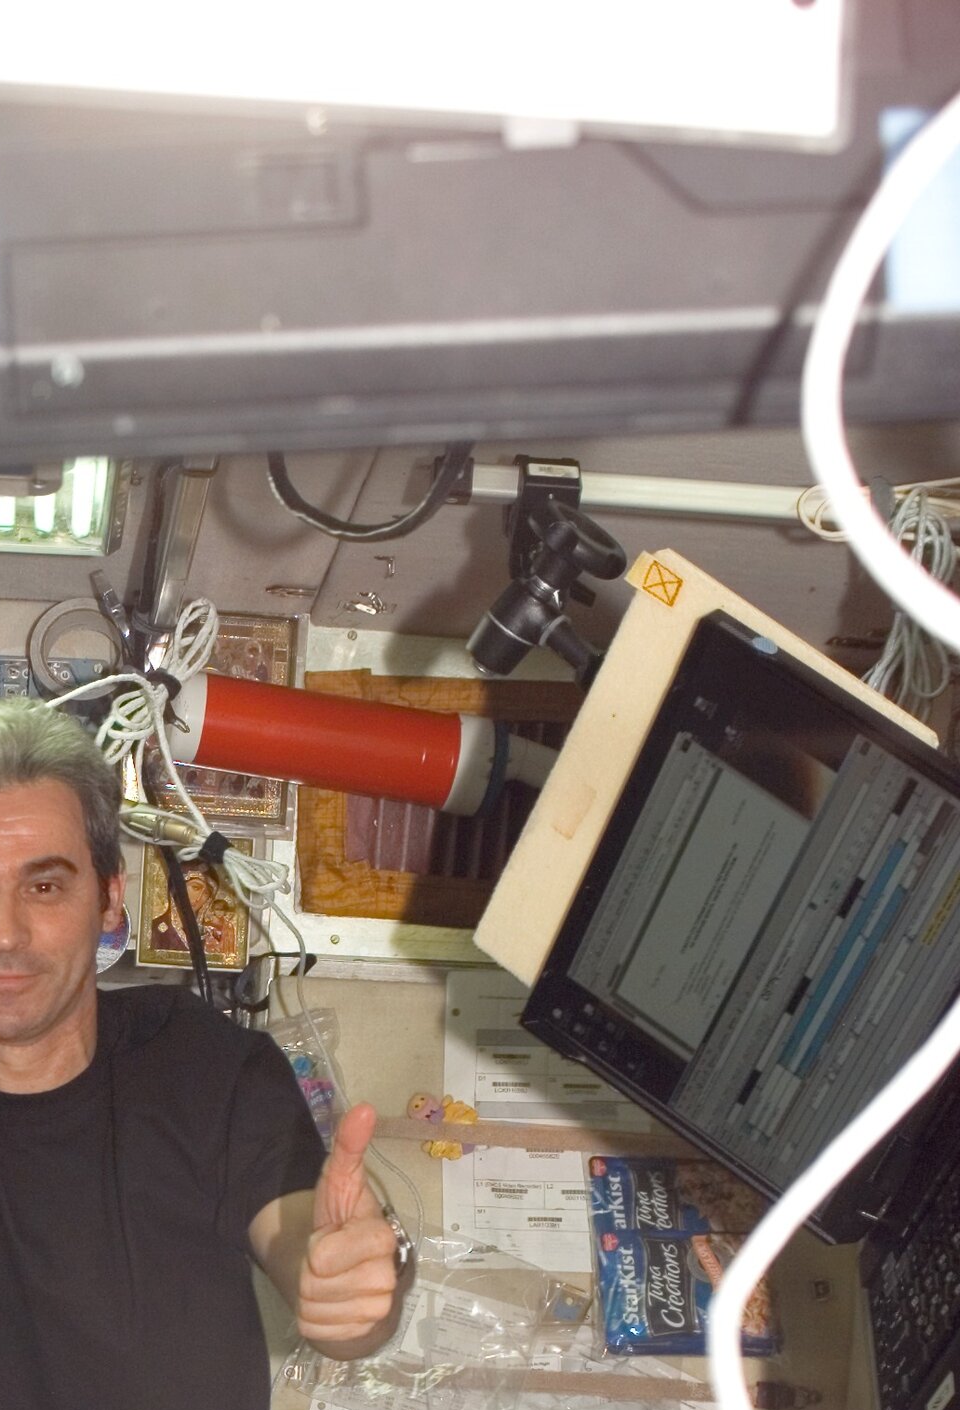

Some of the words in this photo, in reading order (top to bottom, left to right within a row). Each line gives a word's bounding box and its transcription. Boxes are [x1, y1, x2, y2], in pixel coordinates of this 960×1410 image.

[608, 1175, 628, 1230] arKist
[636, 1191, 656, 1230] Tuna
[649, 1170, 673, 1231] reations
[619, 1244, 639, 1325] StarKist
[647, 1265, 667, 1307] Tuna
[661, 1243, 686, 1328] Creations
